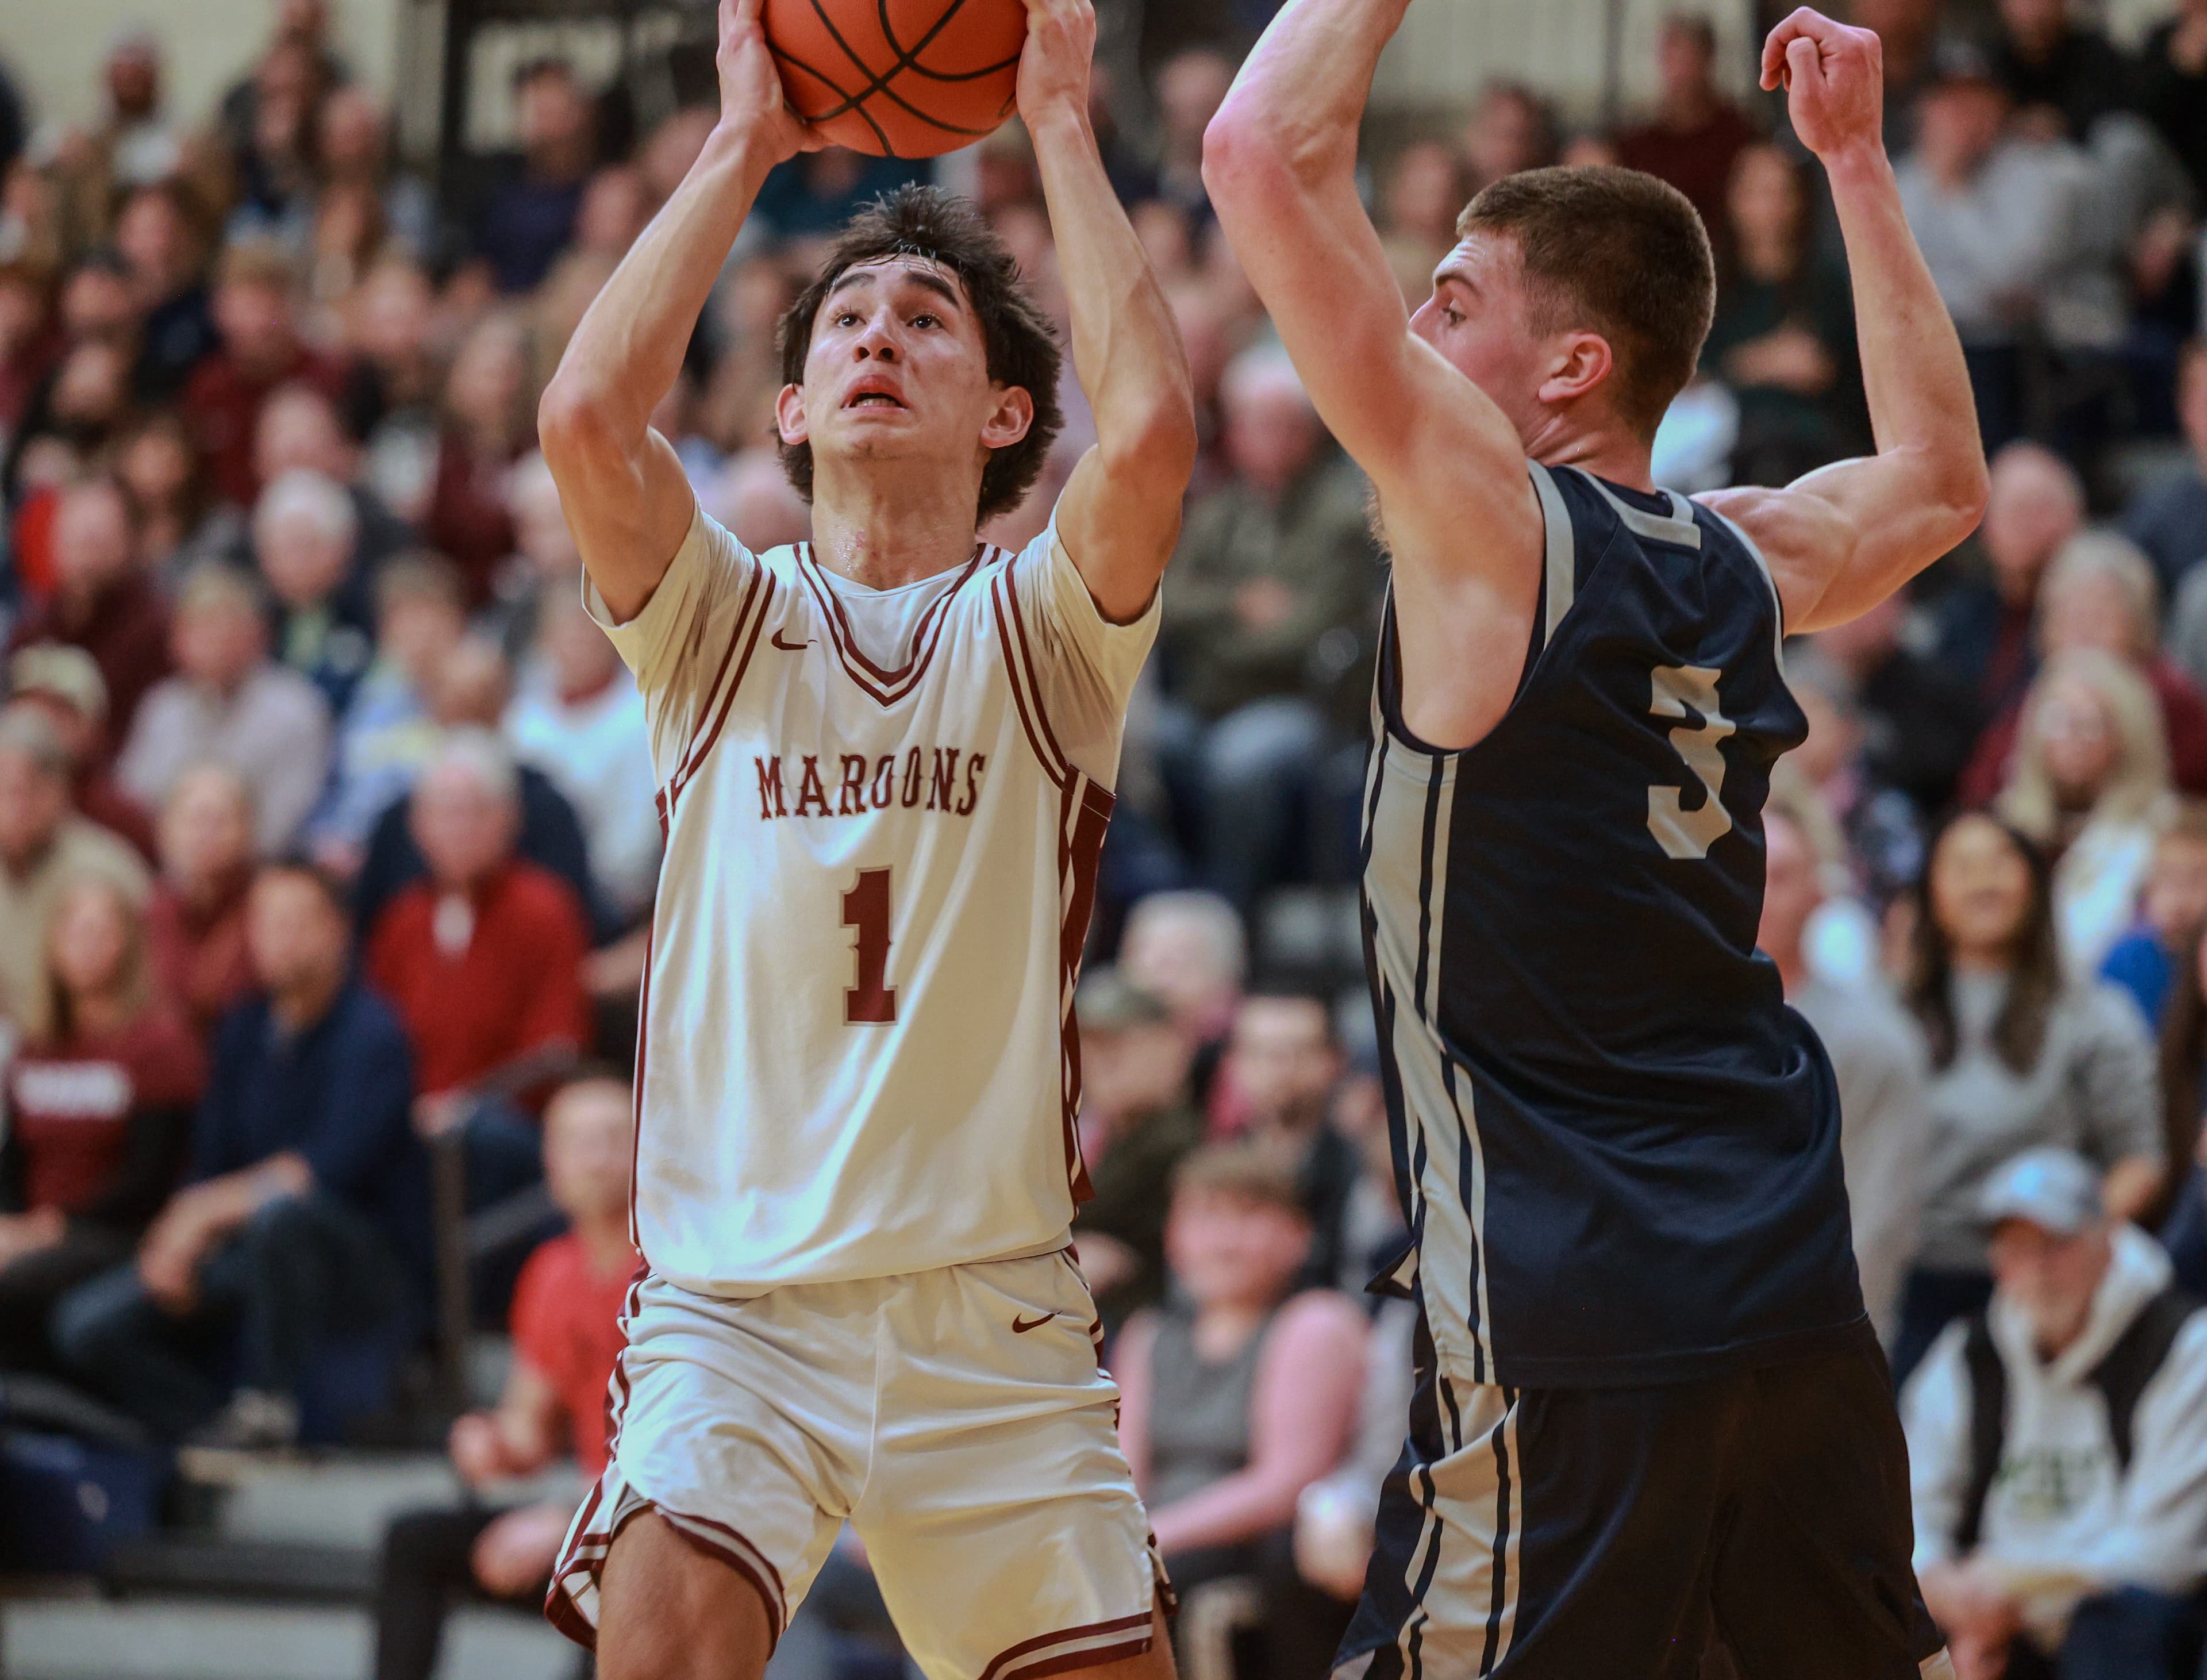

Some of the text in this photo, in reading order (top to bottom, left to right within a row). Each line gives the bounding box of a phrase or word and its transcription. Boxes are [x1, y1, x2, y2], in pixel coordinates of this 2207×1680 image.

[754, 745, 987, 820] MAROONS
[1647, 664, 1736, 859] 3
[839, 865, 898, 1026] 1
